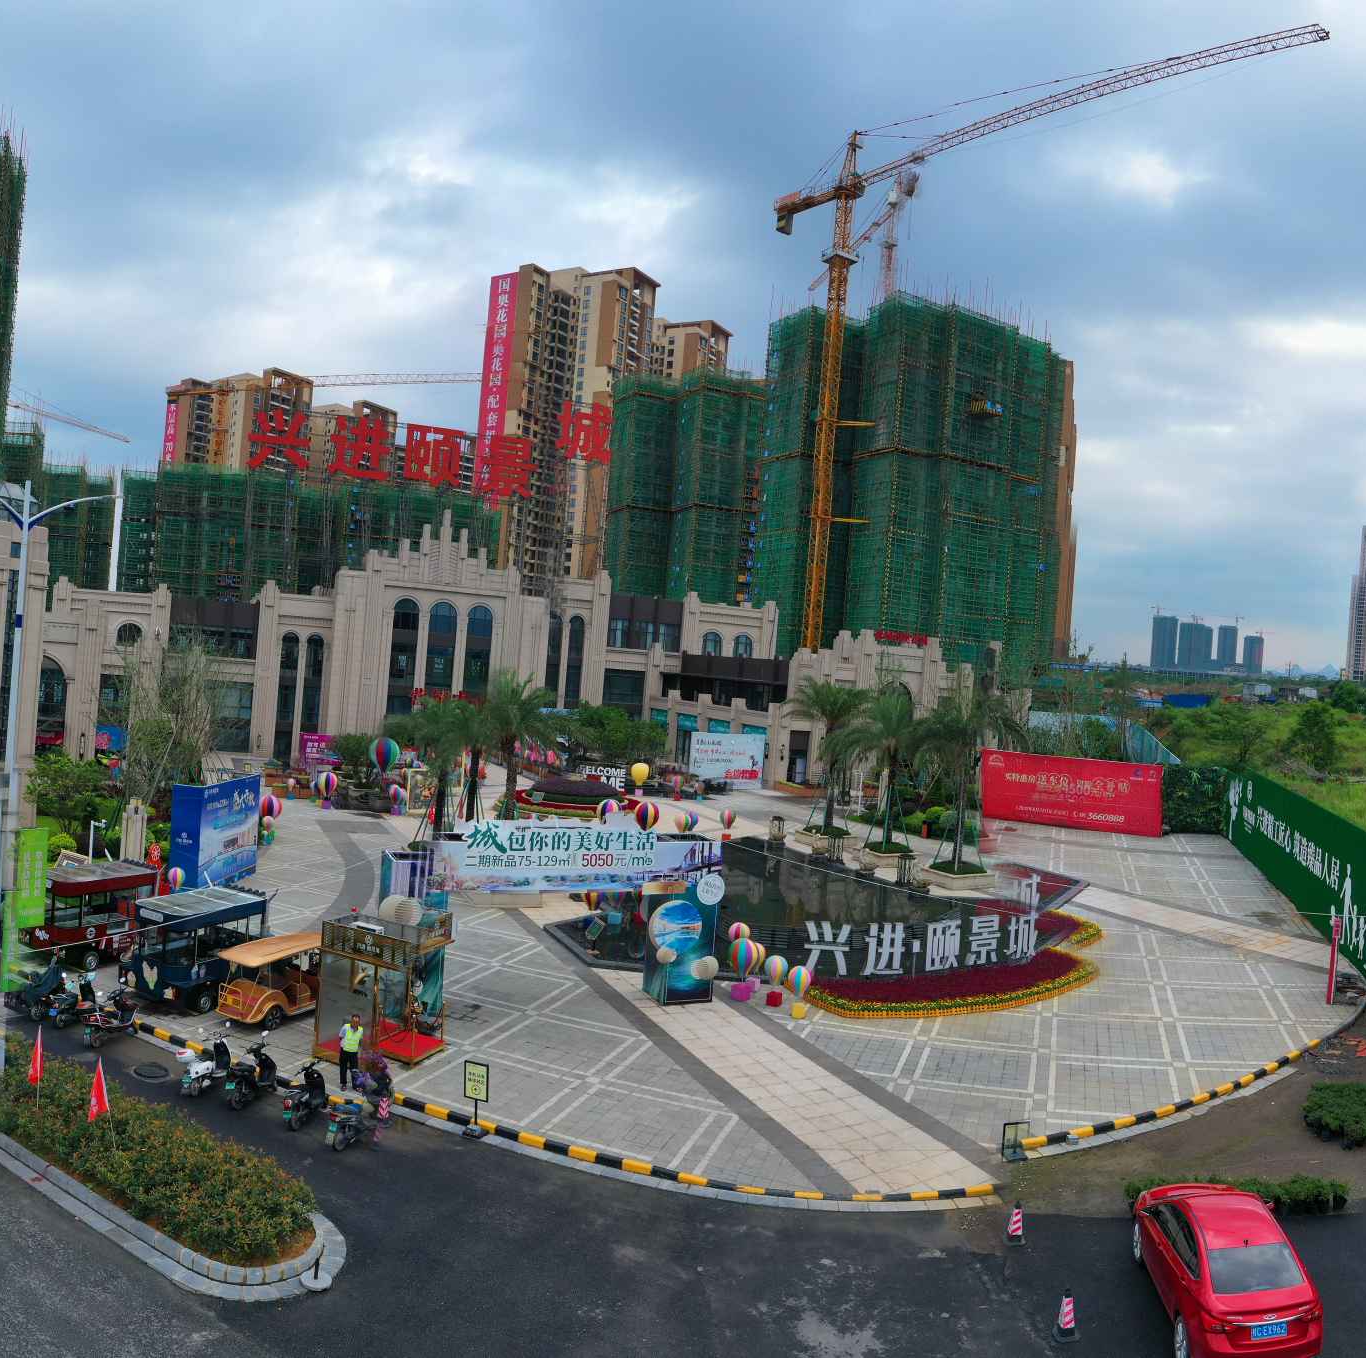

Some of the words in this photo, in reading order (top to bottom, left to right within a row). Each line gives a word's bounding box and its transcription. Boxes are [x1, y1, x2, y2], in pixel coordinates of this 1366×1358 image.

[247, 402, 615, 498] 兴进颐景城
[466, 820, 656, 854] 城包你的美好生活
